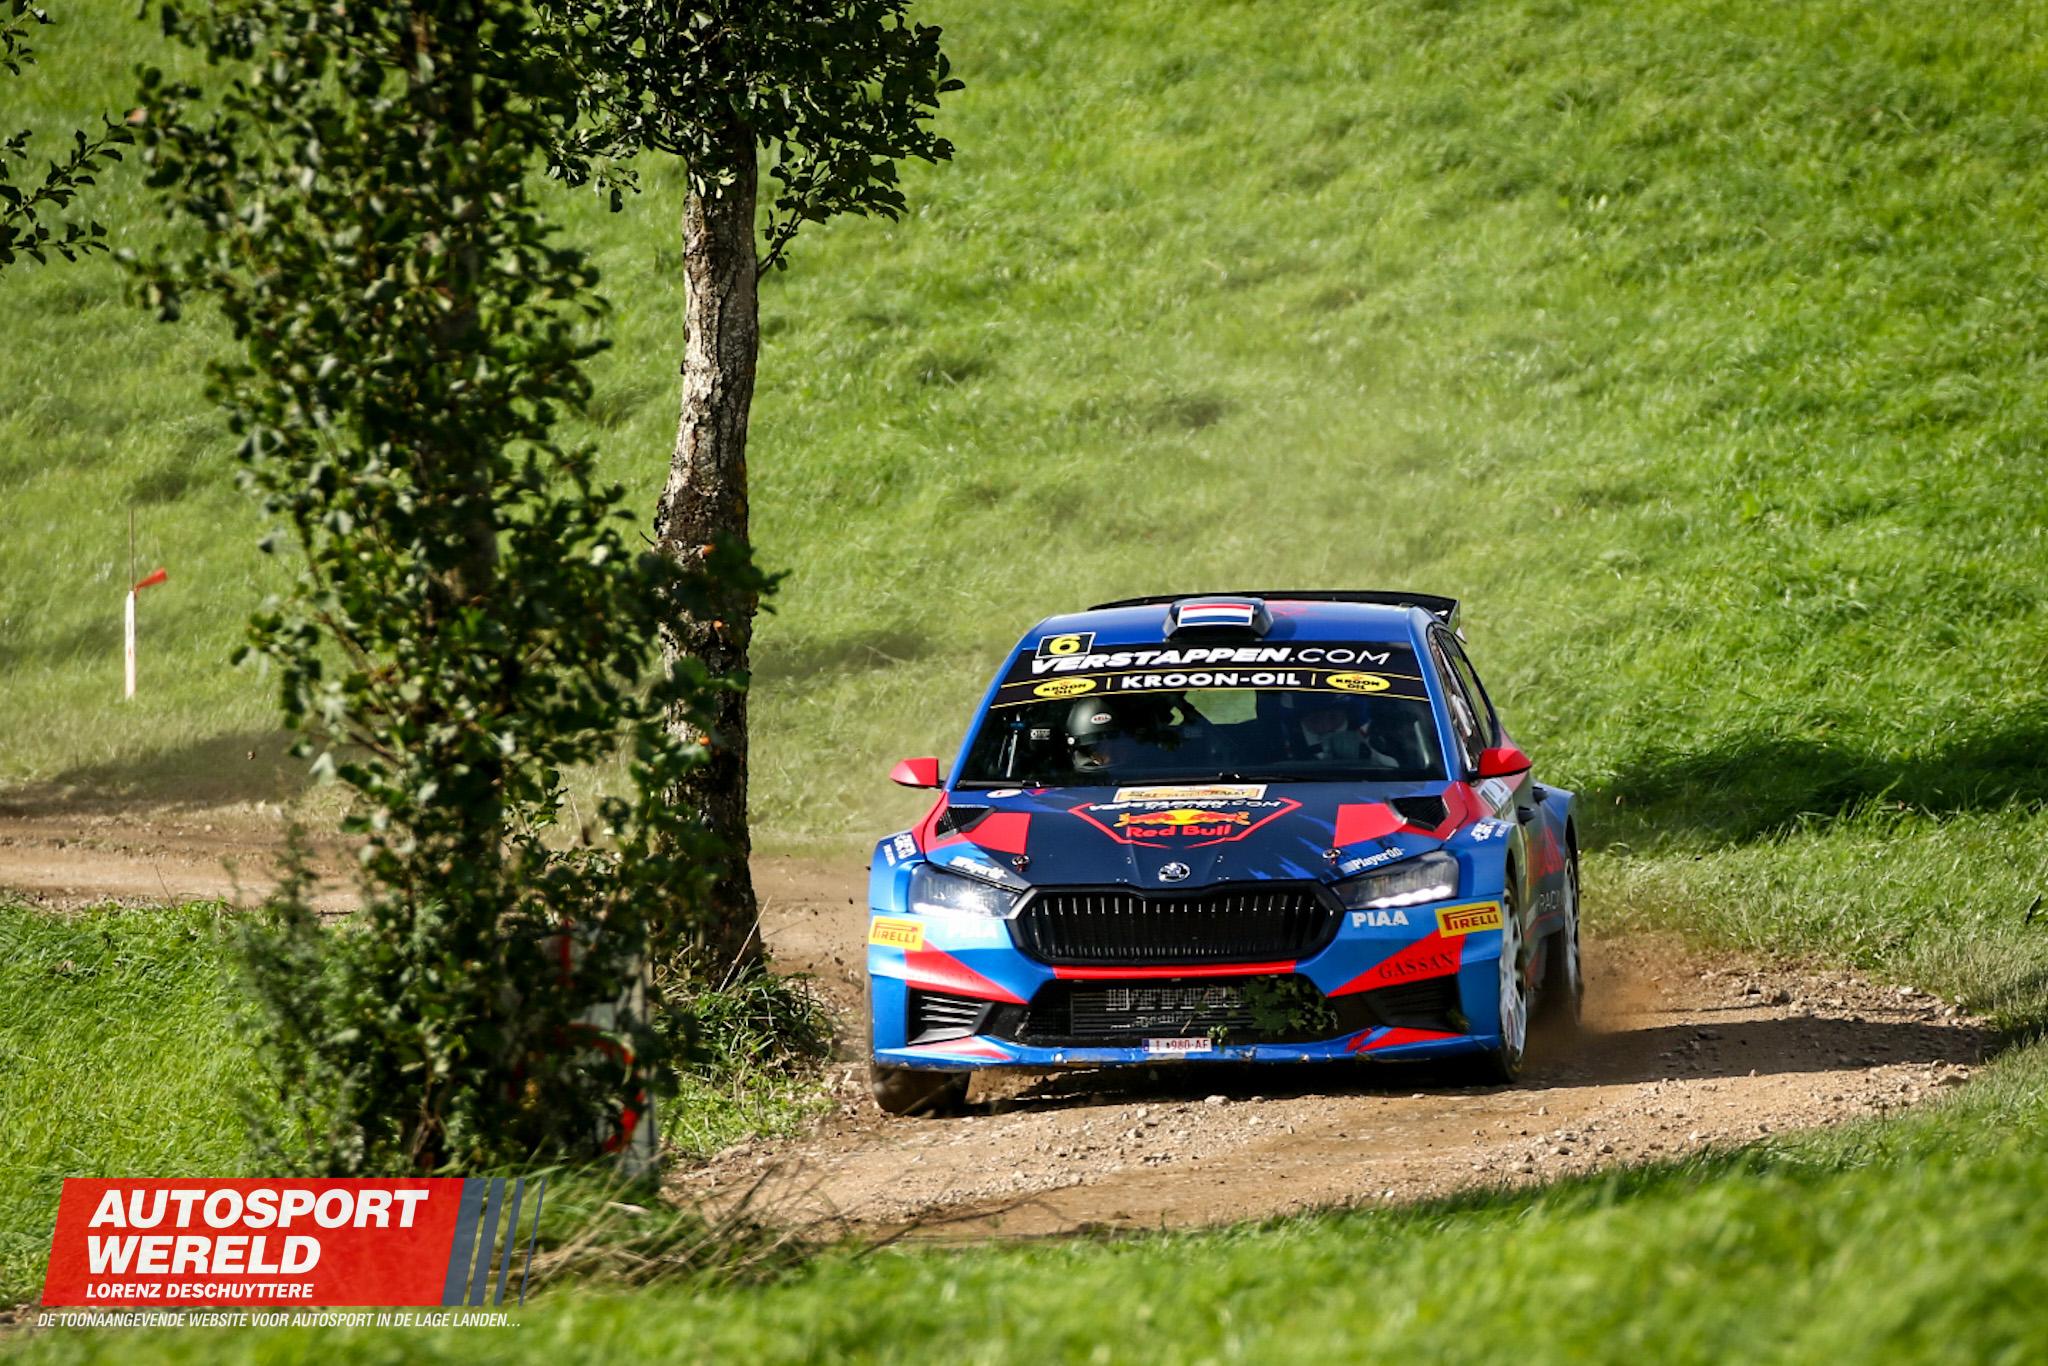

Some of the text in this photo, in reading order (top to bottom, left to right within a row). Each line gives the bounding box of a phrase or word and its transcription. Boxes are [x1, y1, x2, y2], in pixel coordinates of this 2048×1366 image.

[1049, 635, 1081, 655] 6
[1031, 647, 1391, 674] VERSTAPPEN.COM
[1121, 672, 1301, 689] KROON-OIL
[1335, 677, 1380, 687] KROON
[1125, 824, 1232, 837] Red Bull
[1352, 910, 1409, 928] PIAA
[1442, 906, 1499, 930] PIRELLI
[872, 922, 919, 944] PIRELLI
[1379, 950, 1457, 979] GASSAN
